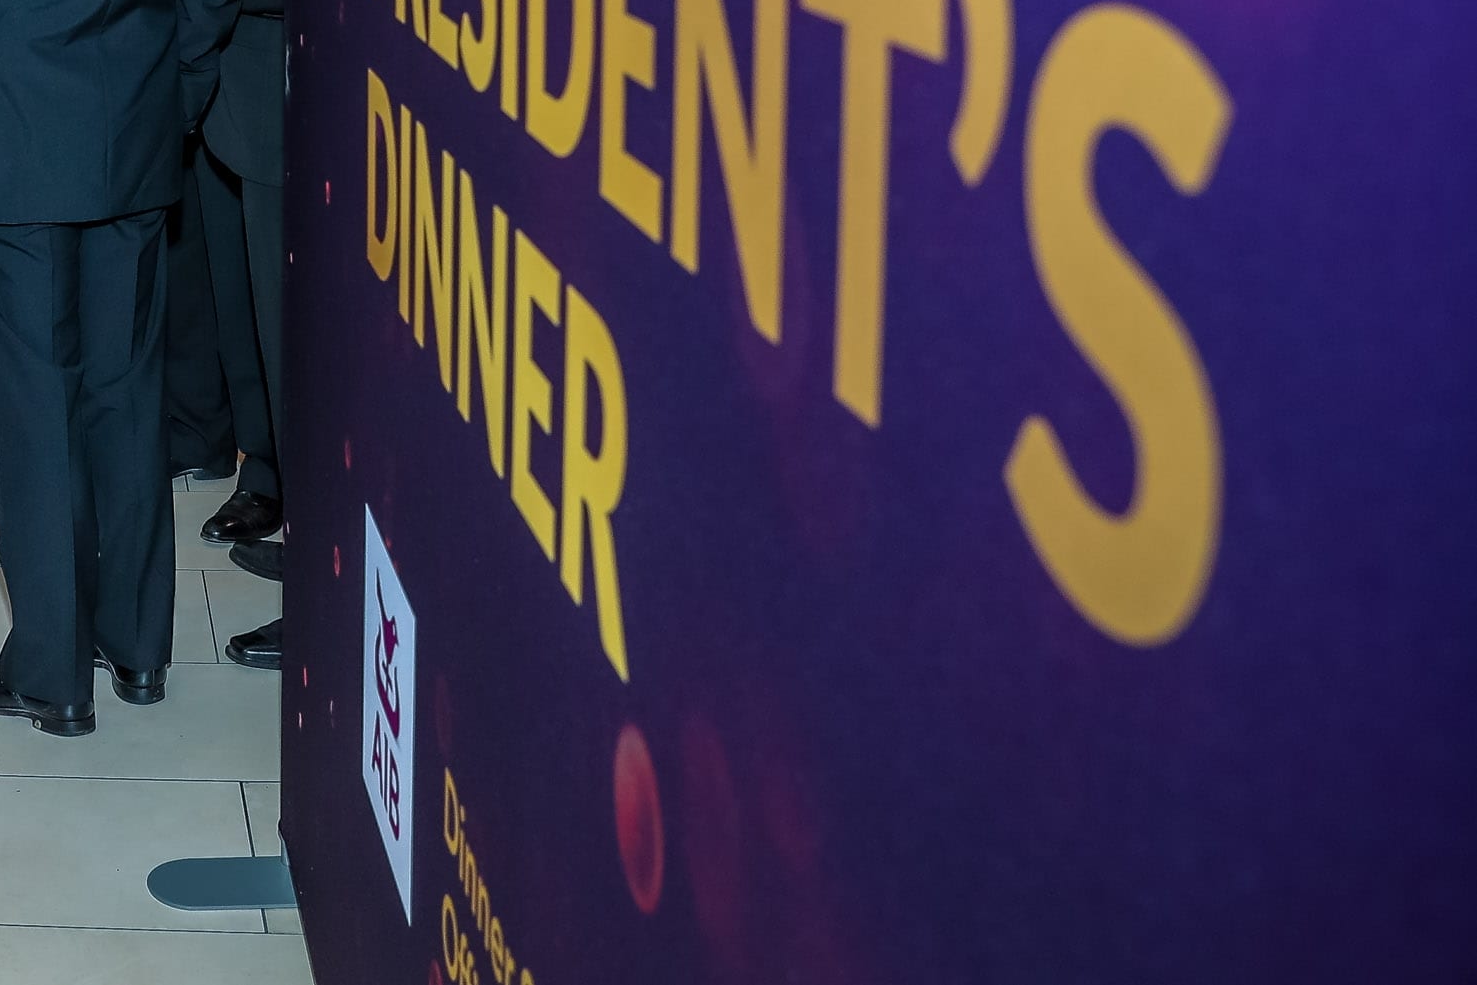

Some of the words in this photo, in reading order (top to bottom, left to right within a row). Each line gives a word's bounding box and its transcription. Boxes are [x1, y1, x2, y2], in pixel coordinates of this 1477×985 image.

[367, 68, 629, 683] DINNER
[371, 709, 400, 842] AIB
[444, 766, 516, 985] Dinner
